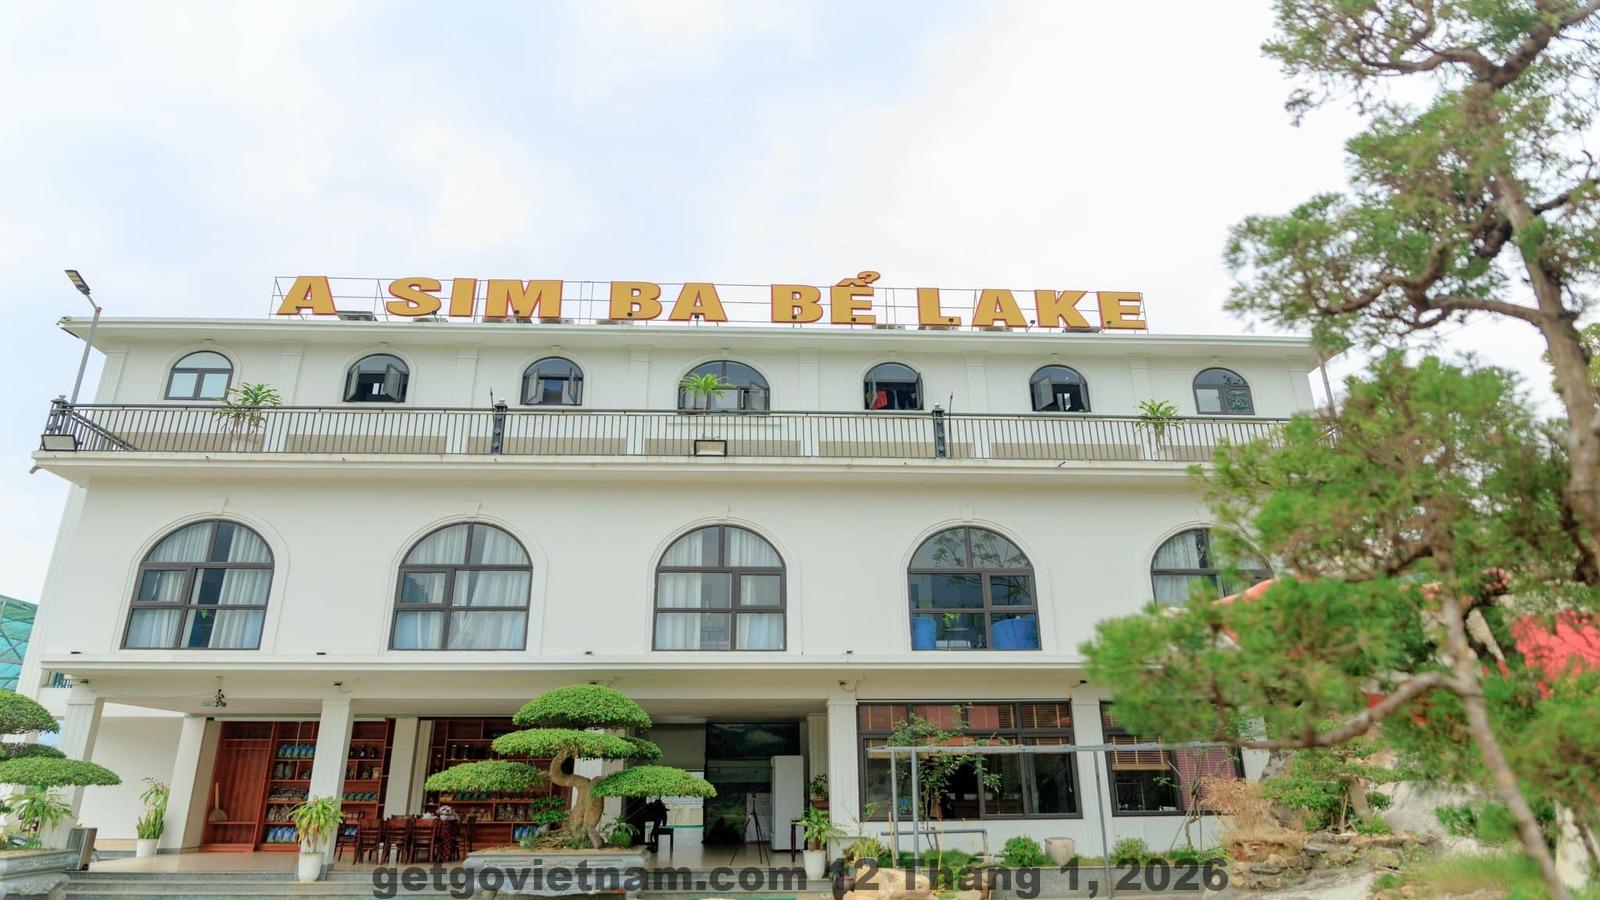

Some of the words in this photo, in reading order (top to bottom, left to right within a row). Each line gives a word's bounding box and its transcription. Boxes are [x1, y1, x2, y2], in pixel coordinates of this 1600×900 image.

[276, 275, 336, 317] A
[386, 276, 563, 319] SIM
[610, 281, 728, 322] BA
[771, 272, 880, 325] BỂ
[916, 287, 1147, 330] LAKE
